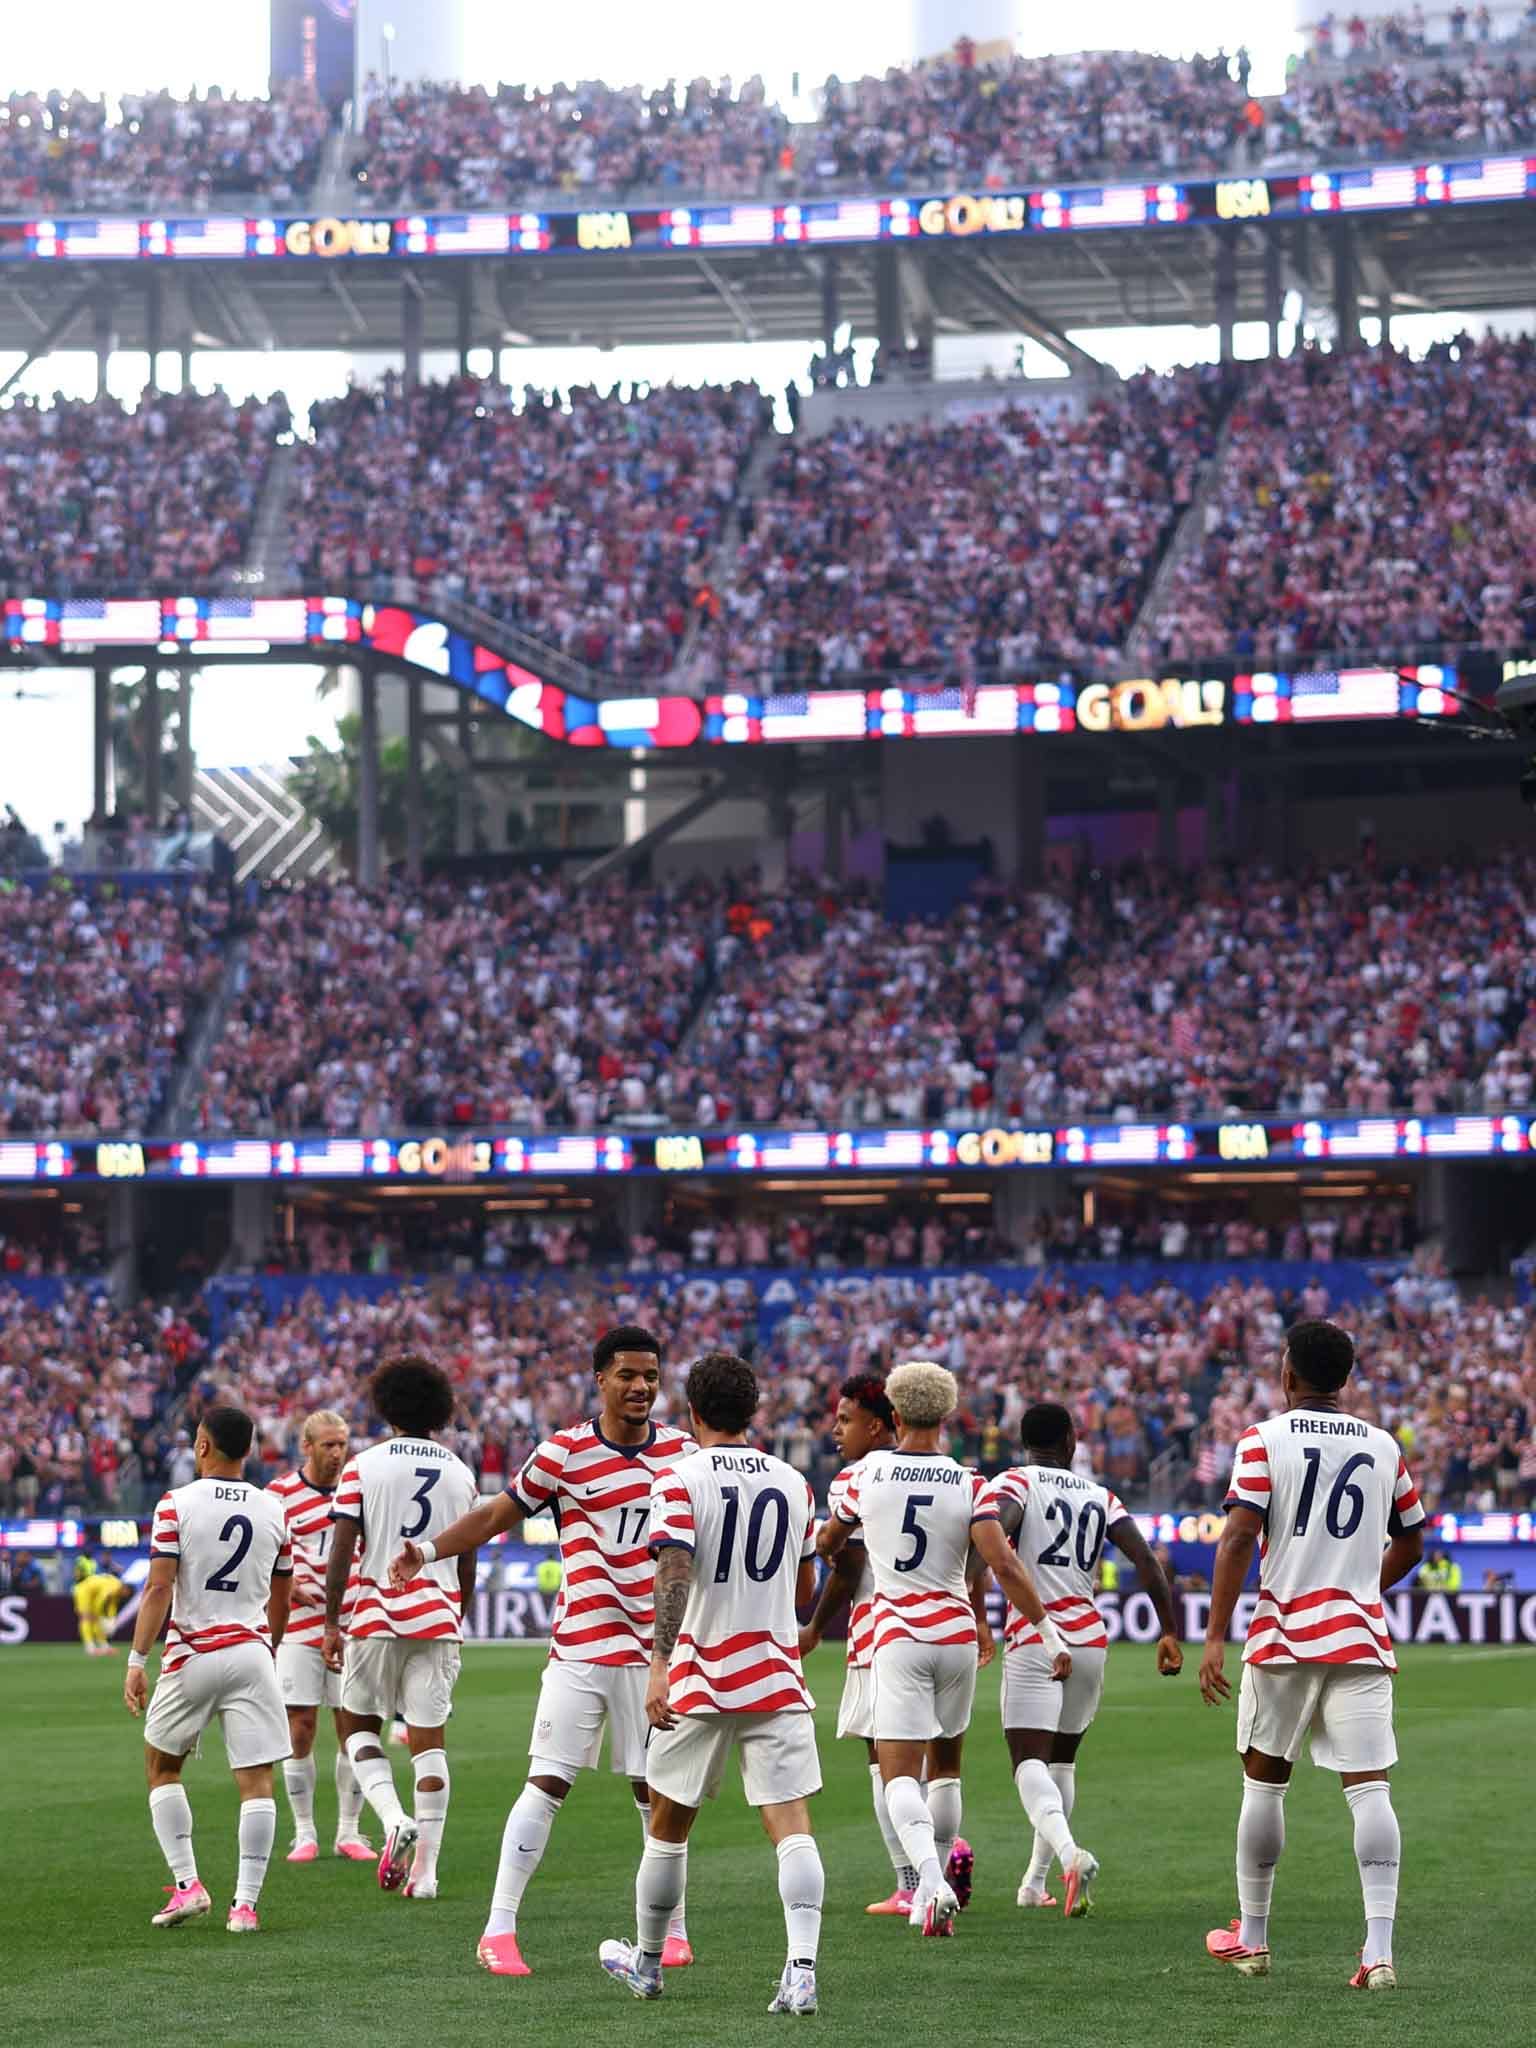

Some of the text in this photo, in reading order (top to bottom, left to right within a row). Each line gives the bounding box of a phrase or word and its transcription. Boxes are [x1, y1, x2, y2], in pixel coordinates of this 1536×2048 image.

[1076, 678, 1226, 732] GOAL!
[398, 1137, 492, 1175] GOL!
[1290, 1418, 1368, 1438] FREEMAN
[390, 1443, 453, 1461] RICHARDS
[712, 1455, 770, 1473] PULISIC
[215, 1486, 248, 1502] DEST
[890, 1466, 962, 1486] ROBINSON
[1293, 1447, 1375, 1540] 16
[400, 1467, 441, 1538] 3
[617, 1507, 650, 1544] 17
[205, 1514, 253, 1592] 2
[714, 1486, 789, 1583] 10
[894, 1495, 934, 1572] 5
[1038, 1498, 1105, 1572] 20
